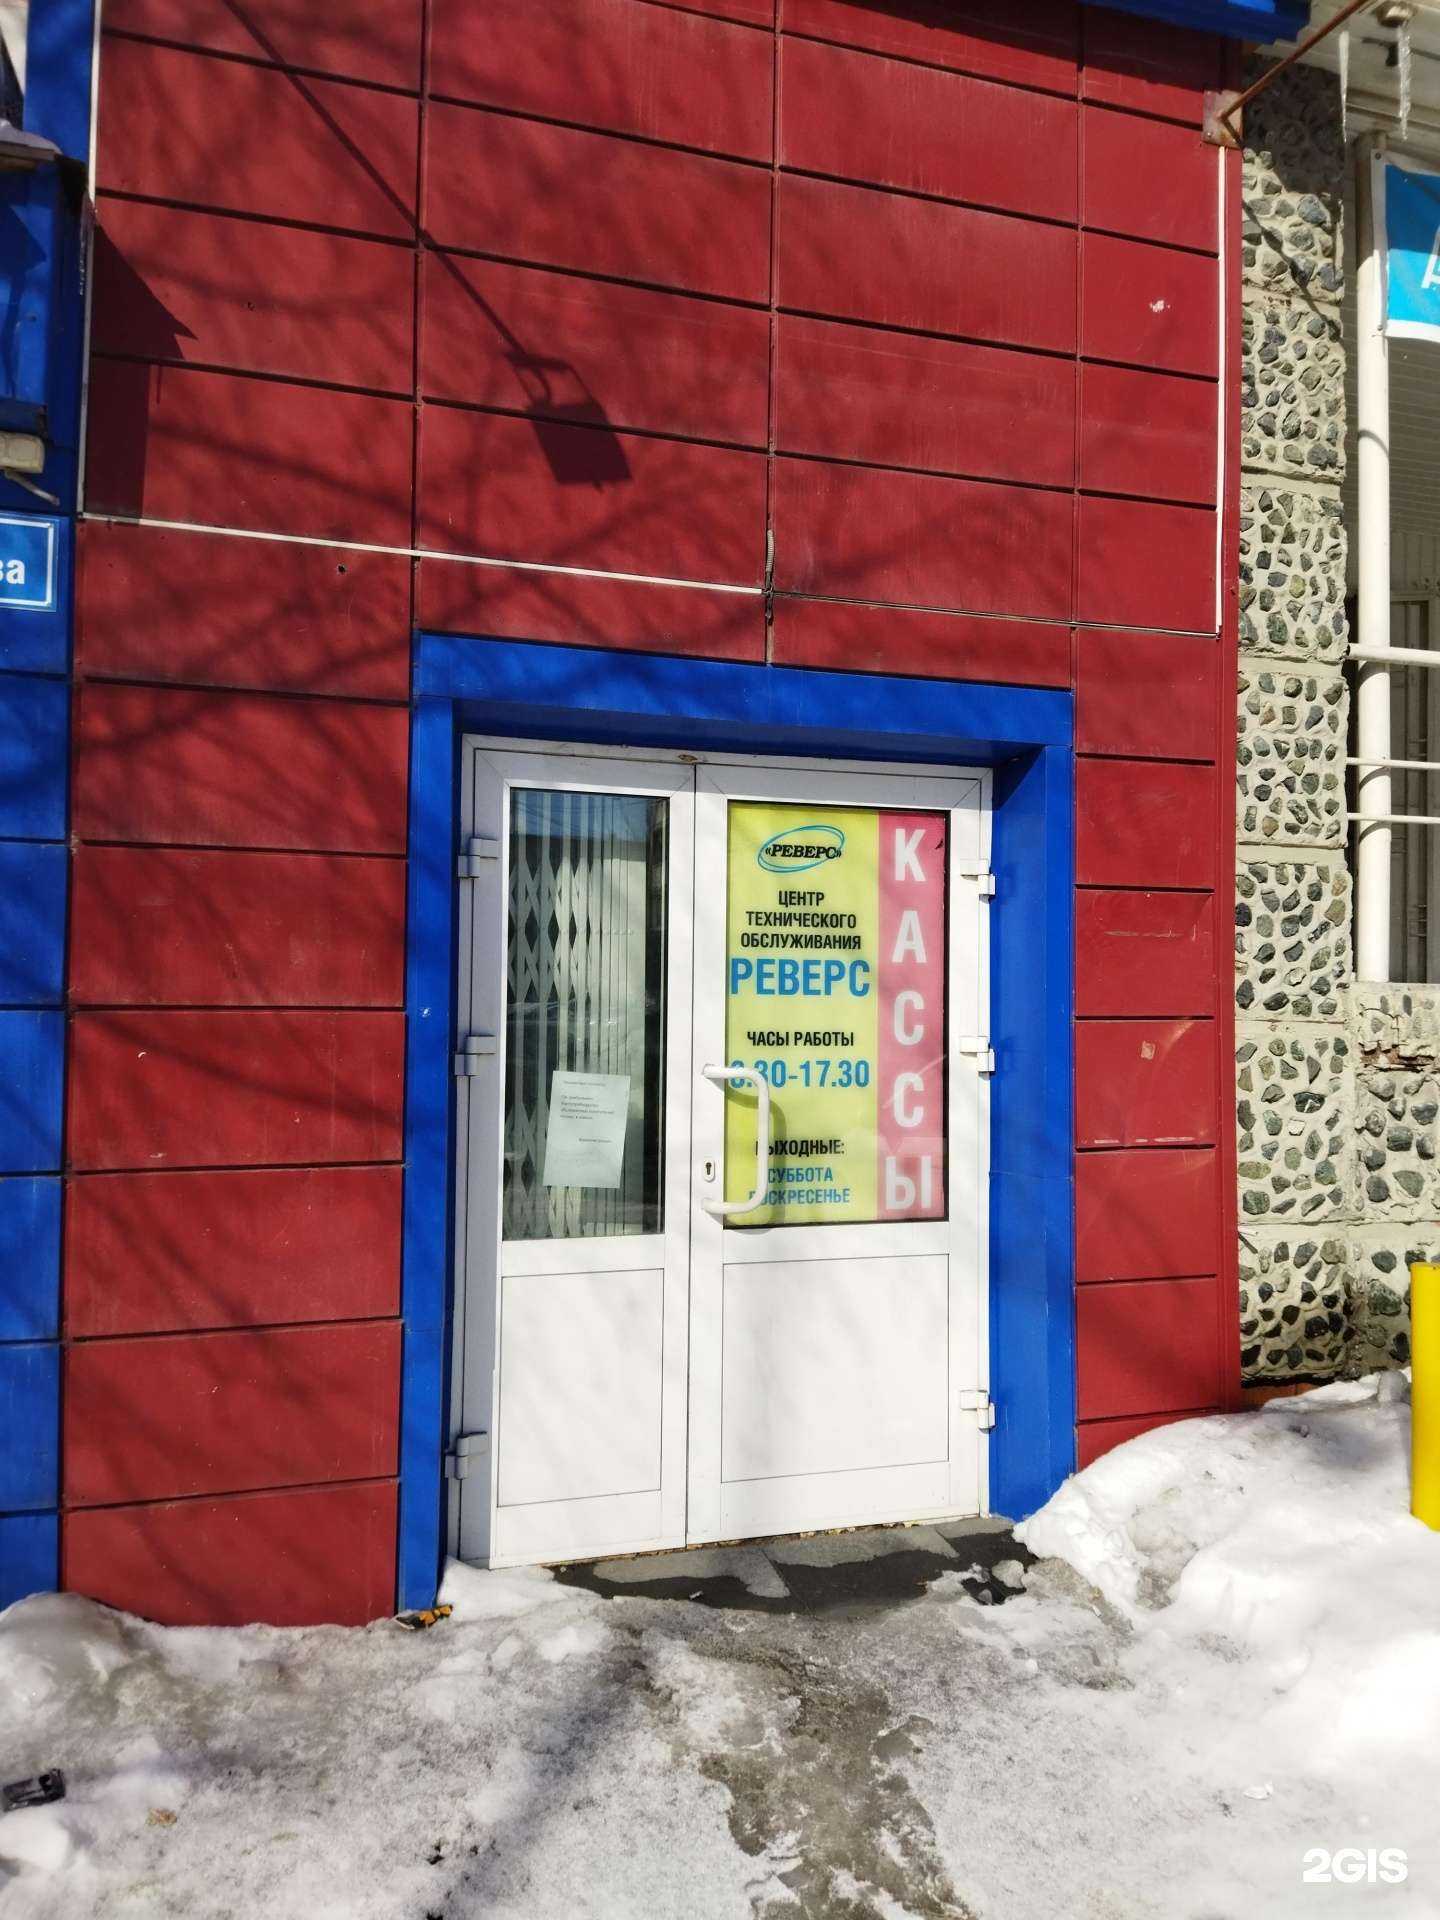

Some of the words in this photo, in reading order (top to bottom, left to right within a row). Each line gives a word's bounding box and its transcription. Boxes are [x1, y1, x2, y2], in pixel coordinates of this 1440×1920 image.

[778, 890, 825, 908] ЦЕНТР
[745, 911, 857, 929] ТЕХНИЧЕСКОГО
[740, 932, 861, 950] ОБСЛУЖИВАНИЯ
[731, 958, 870, 997] РЕВЕРС
[884, 827, 932, 1211] КАССЫ
[747, 1031, 790, 1047] ЧАСЫ
[794, 1031, 854, 1047] РАБОТЫ
[767, 1167, 834, 1184] СУББОТА
